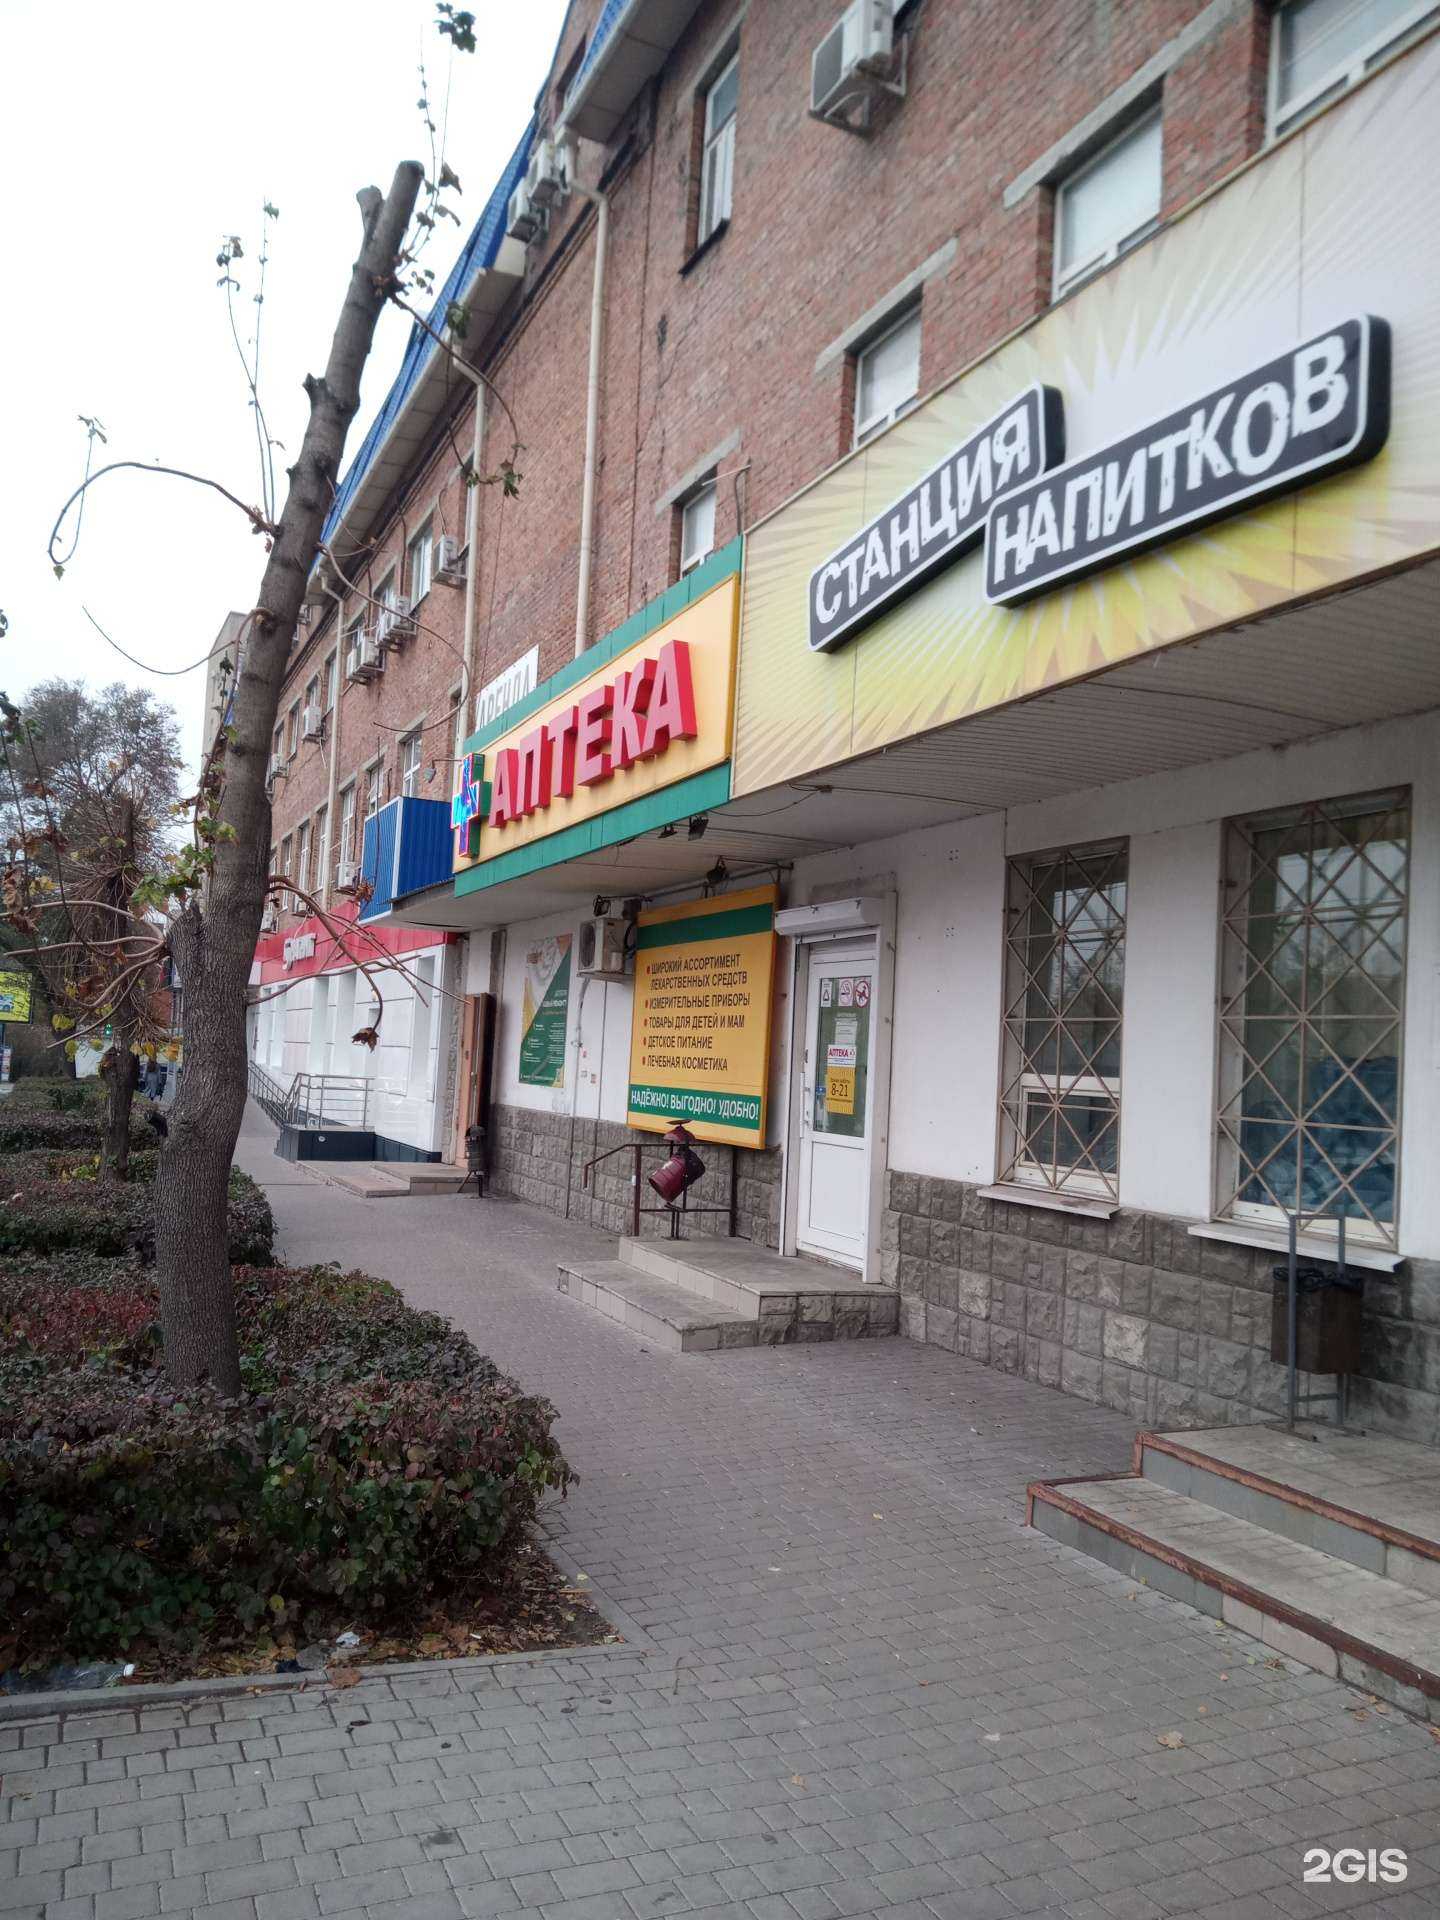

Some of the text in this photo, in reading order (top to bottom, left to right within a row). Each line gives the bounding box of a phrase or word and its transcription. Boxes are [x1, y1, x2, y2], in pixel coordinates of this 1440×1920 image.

[993, 334, 1350, 585] НАПИТКОВ
[814, 404, 1032, 625] СТАНЦИЯ
[489, 640, 697, 828] АПТЕКА
[651, 954, 740, 974] ШИРОКИЙ АССОРТИМЕНТ
[651, 971, 747, 990] ЛЕКАРСТВЕННЫХ СРЕДСТВ
[649, 993, 750, 1009] ИЗМЕРИТЕЛЬНЫЕ ПРИБОРЫ
[649, 1012, 745, 1030] ТОВАРЫ ДЛЯ ДЕТЕЙ И МАМ
[648, 1035, 713, 1049] ДЕТСКОЕ ПИТАНИЕ
[829, 1048, 848, 1057] АПТЕКА
[647, 1055, 728, 1071] ЛЕЧЕБНАЯ КОСМЕТИКА
[831, 1083, 848, 1097] 8-21
[631, 1088, 759, 1120] НАДЁЖНО! ВЫГОДНО! УДОБНО!
